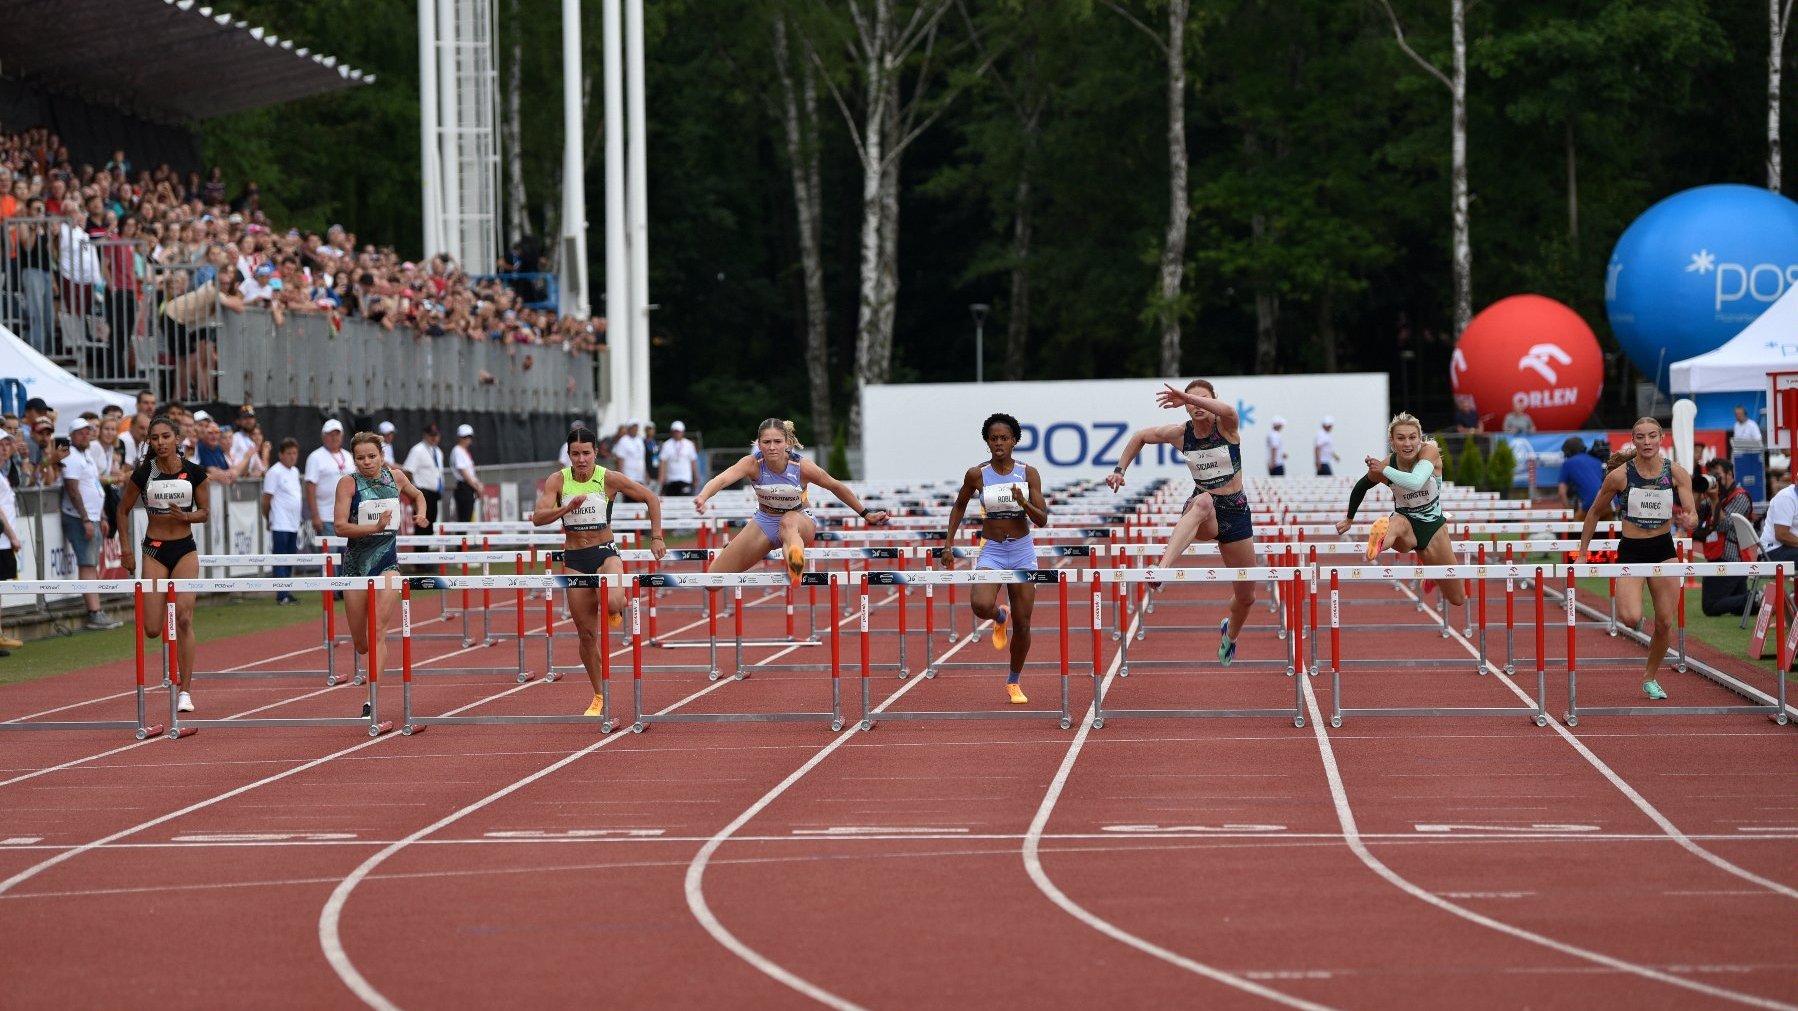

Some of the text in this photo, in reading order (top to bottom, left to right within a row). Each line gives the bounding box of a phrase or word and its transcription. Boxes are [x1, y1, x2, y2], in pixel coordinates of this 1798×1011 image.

[1512, 387, 1578, 408] ORLEN
[154, 491, 185, 500] MAJEWSKA
[1402, 490, 1430, 500] FORSTER
